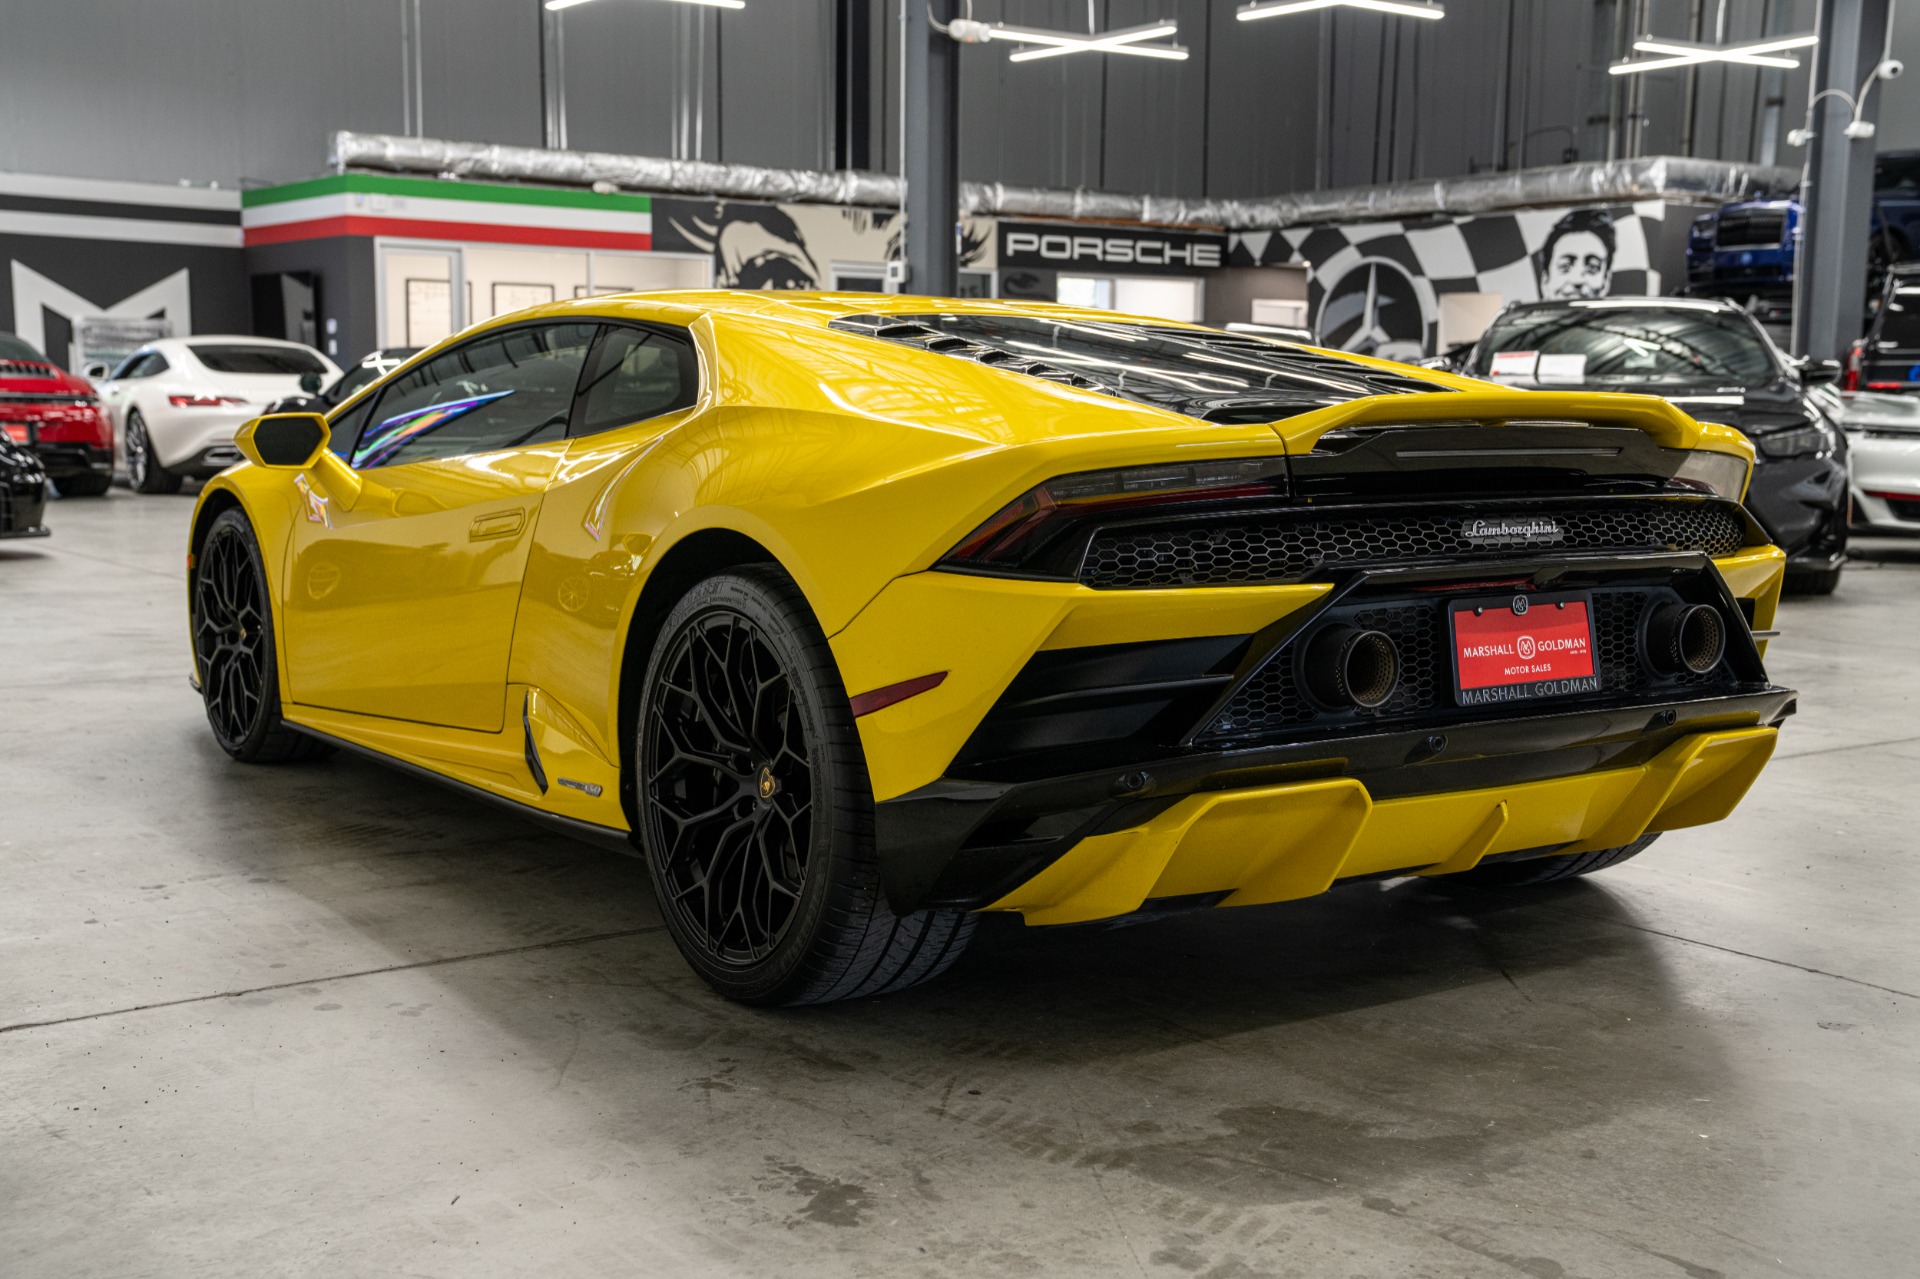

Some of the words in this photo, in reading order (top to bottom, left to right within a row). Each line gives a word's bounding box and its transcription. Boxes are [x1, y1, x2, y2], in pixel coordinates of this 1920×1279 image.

[1006, 232, 1222, 268] PORSCHE
[1465, 520, 1558, 538] Lamborghini
[1463, 643, 1515, 658] MARSHALL
[1537, 638, 1586, 652] GOLDMAN
[1504, 665, 1530, 675] MOTOR
[1531, 663, 1552, 673] SALES
[1462, 684, 1532, 705] MARSHALL
[1535, 677, 1598, 696] GOLDMAN
